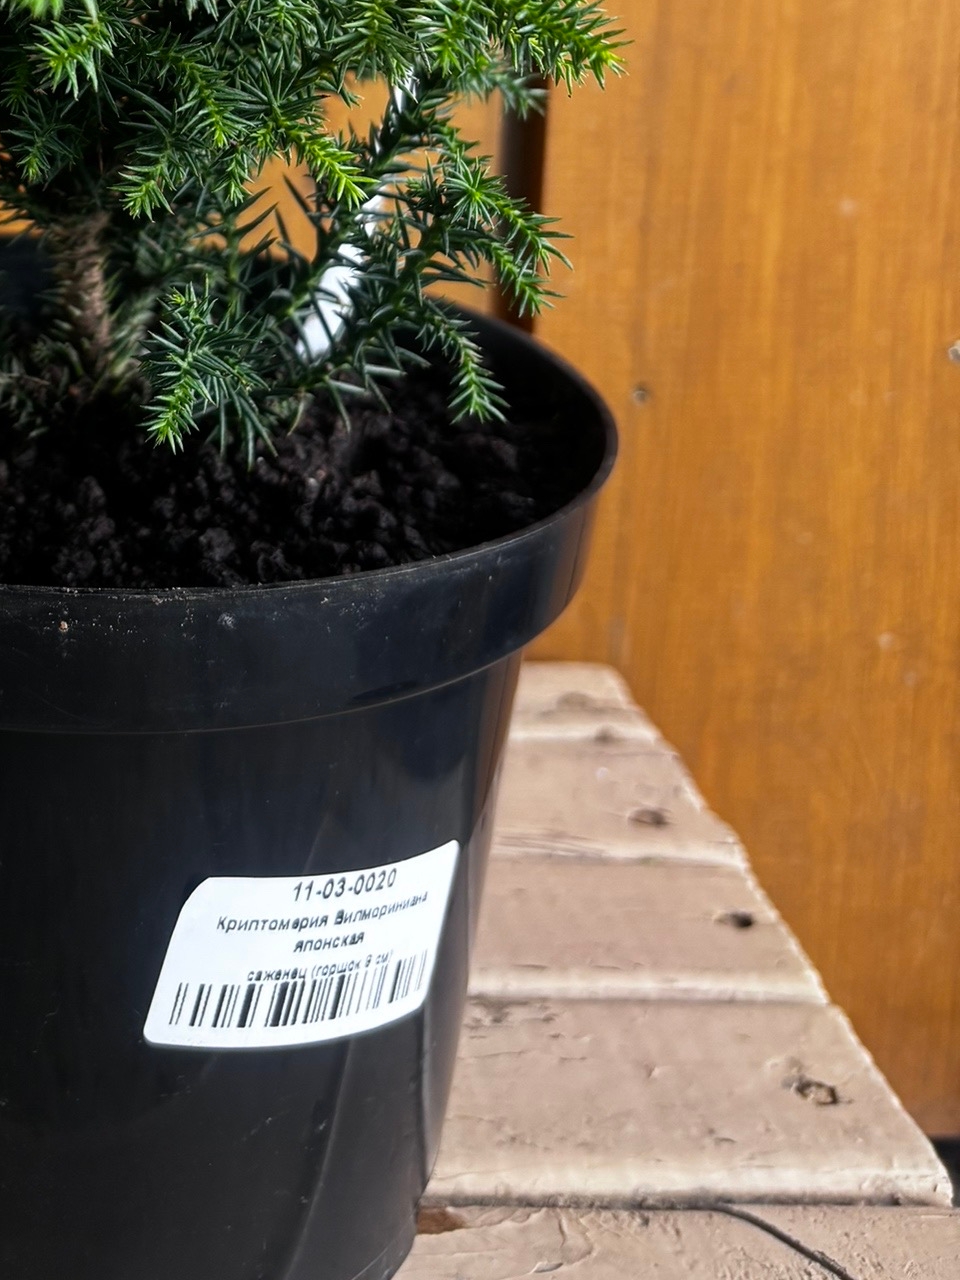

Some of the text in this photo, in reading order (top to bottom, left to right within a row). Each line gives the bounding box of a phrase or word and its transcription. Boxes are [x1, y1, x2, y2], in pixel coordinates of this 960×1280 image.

[292, 867, 397, 902] 11-03-0020
[216, 915, 328, 933] Криптомерия
[293, 931, 365, 953] японская
[247, 967, 308, 982] саженец
